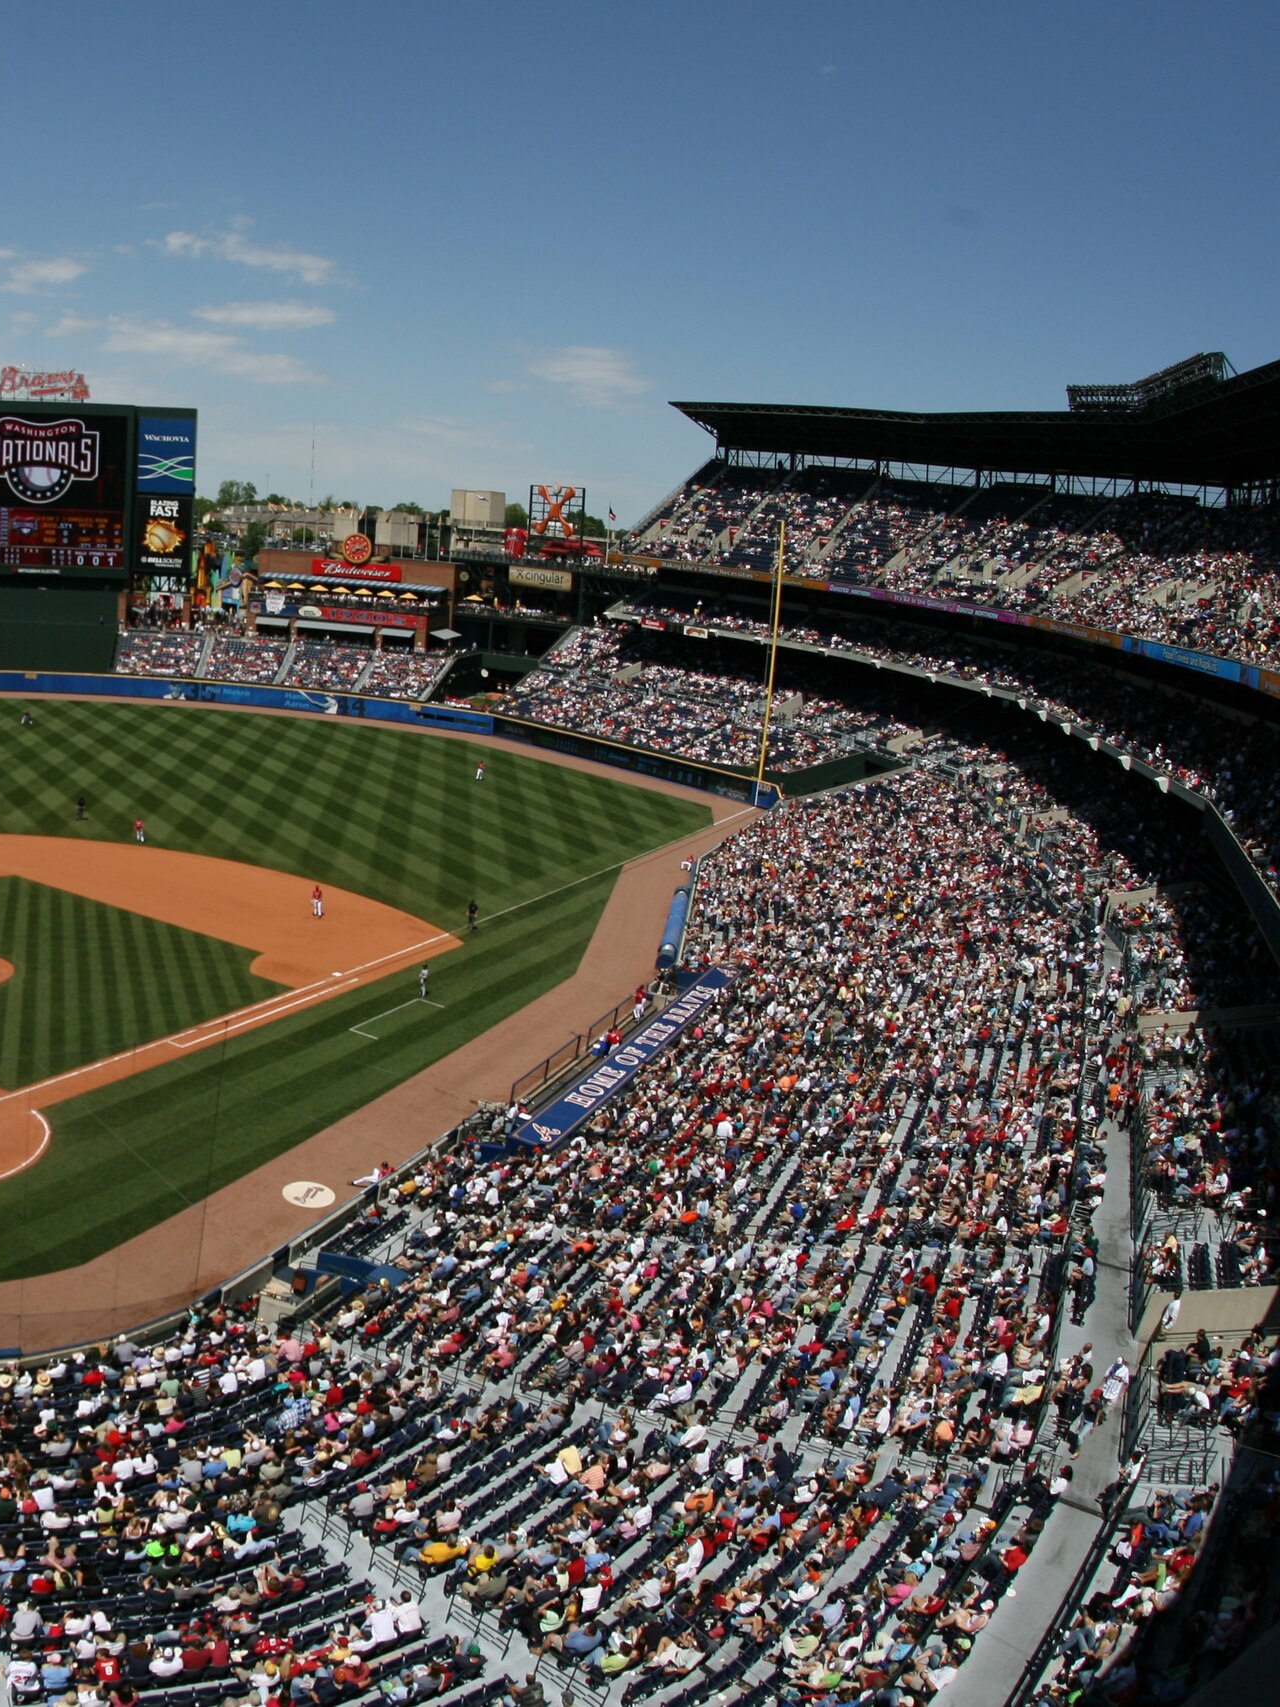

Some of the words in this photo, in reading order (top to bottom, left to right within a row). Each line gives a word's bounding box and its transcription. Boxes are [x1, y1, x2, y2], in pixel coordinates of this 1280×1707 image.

[5, 423, 76, 437] WASHINGTON
[77, 555, 84, 566] 0
[92, 555, 99, 566] 0
[107, 556, 113, 566] 1
[320, 561, 392, 579] Budweiser
[525, 571, 564, 585] cingular
[205, 685, 221, 695] Phil
[222, 687, 250, 698] Niekro
[284, 699, 310, 709] Aaron
[564, 1066, 626, 1109] HOME
[614, 1046, 647, 1070] OF
[634, 1022, 677, 1050] THE
[662, 985, 716, 1026] BRAVES
[105, 1666, 113, 1676] 8
[14, 1675, 32, 1687] 27
